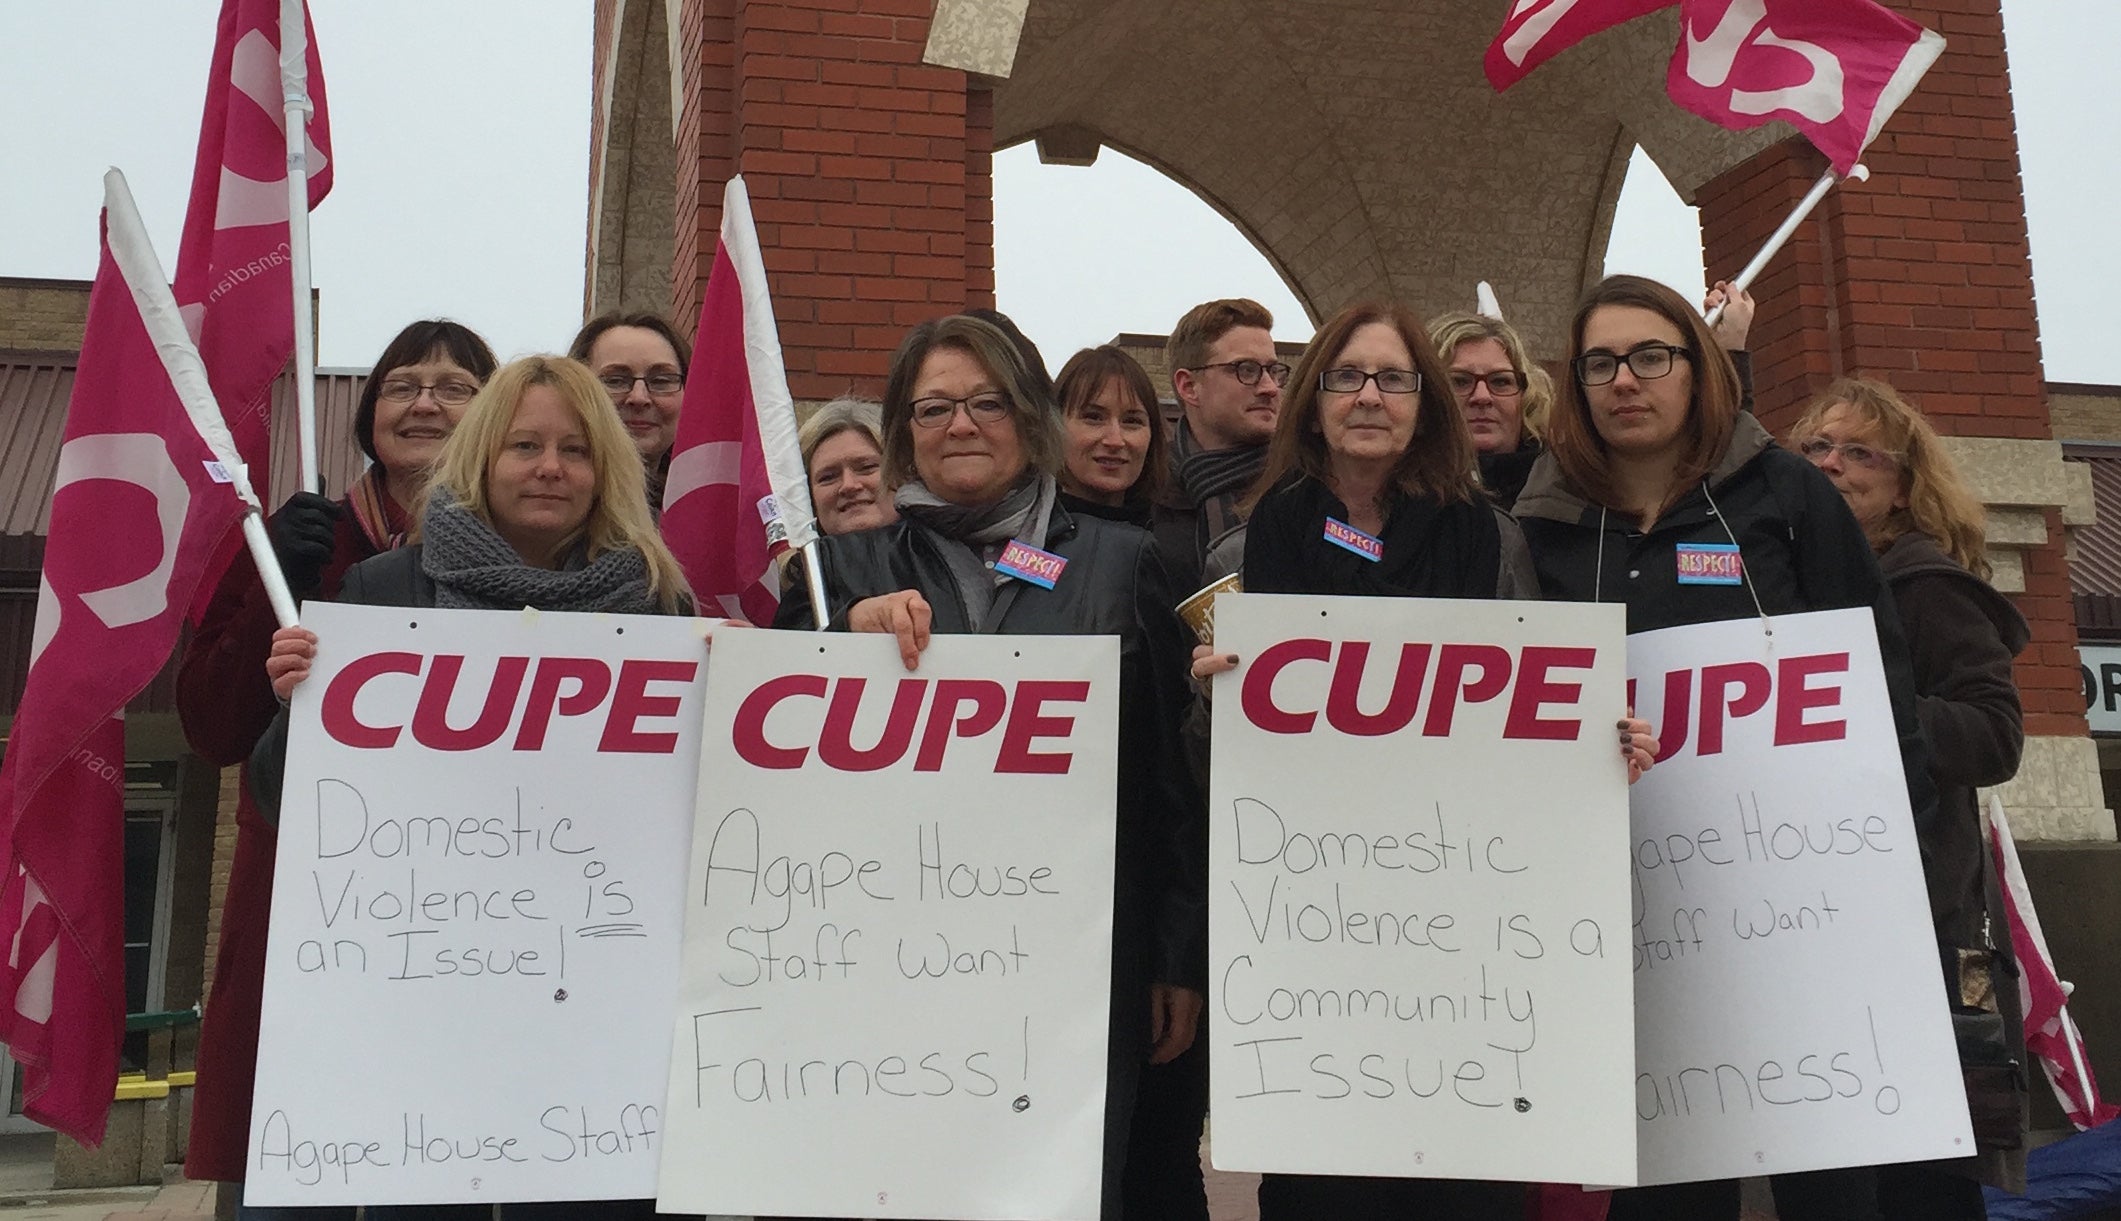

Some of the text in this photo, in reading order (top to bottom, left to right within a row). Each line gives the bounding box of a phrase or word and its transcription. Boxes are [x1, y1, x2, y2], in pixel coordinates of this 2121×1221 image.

[1006, 546, 1061, 578] RESPECT!
[1328, 523, 1380, 555] RESPECT!
[1681, 553, 1736, 573] RESPECT!
[320, 651, 699, 754] CUPE
[731, 673, 1091, 774] CUPE
[1240, 638, 1597, 741] CUPE
[316, 779, 595, 859] Domestic
[1233, 797, 1529, 875] Domestic
[1737, 791, 1894, 862] House
[312, 861, 635, 929] Violence is
[704, 807, 1060, 933] Agape House
[719, 923, 862, 987] Staff
[1231, 875, 1604, 959] Violence is a
[297, 925, 569, 1004] an Issue!
[1223, 955, 1537, 1053] Community
[693, 1007, 1031, 1113] Fairness!
[1233, 1037, 1532, 1113] Issue!
[260, 1104, 658, 1186] Agape House Staff
